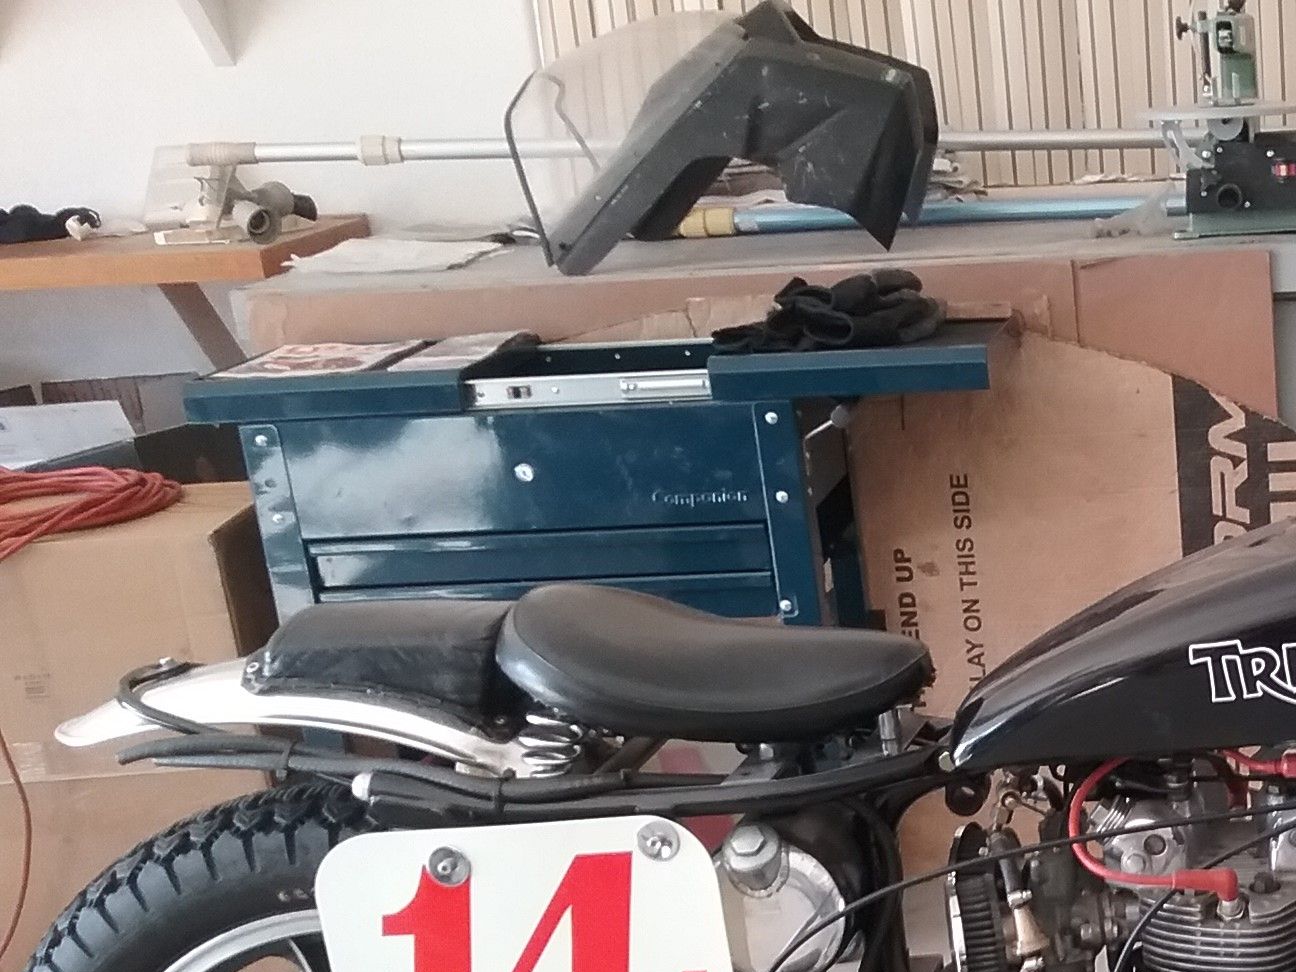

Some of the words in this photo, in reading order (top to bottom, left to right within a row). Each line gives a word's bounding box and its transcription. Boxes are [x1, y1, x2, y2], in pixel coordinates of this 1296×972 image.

[950, 473, 972, 530] SIDE
[893, 548, 914, 583] UP
[955, 537, 978, 591] THIS
[962, 599, 983, 633] ON
